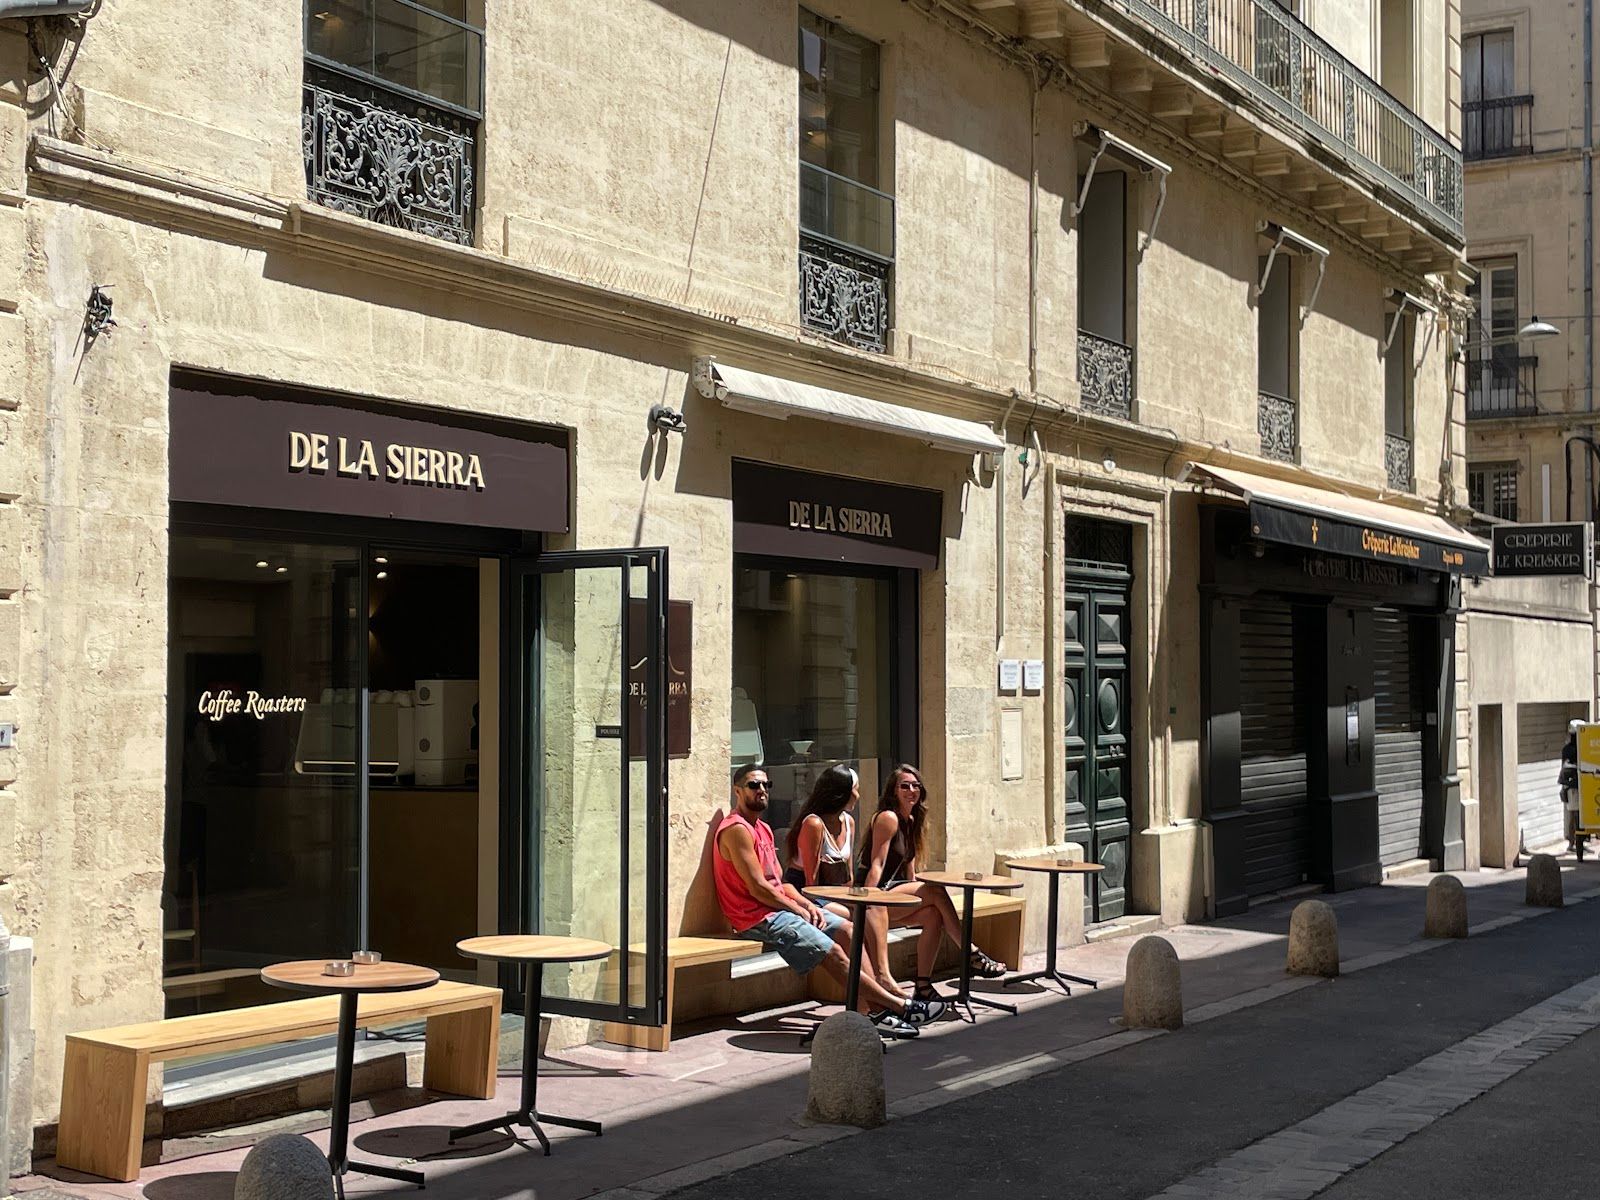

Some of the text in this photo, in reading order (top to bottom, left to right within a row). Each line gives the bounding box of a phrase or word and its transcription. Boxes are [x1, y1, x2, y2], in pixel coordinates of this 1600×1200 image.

[289, 430, 486, 490] DE LA SIERRA
[789, 500, 893, 538] DE LA SIERRA
[1496, 553, 1581, 569] LE KREISKER
[198, 689, 307, 722] Coffee Roasters
